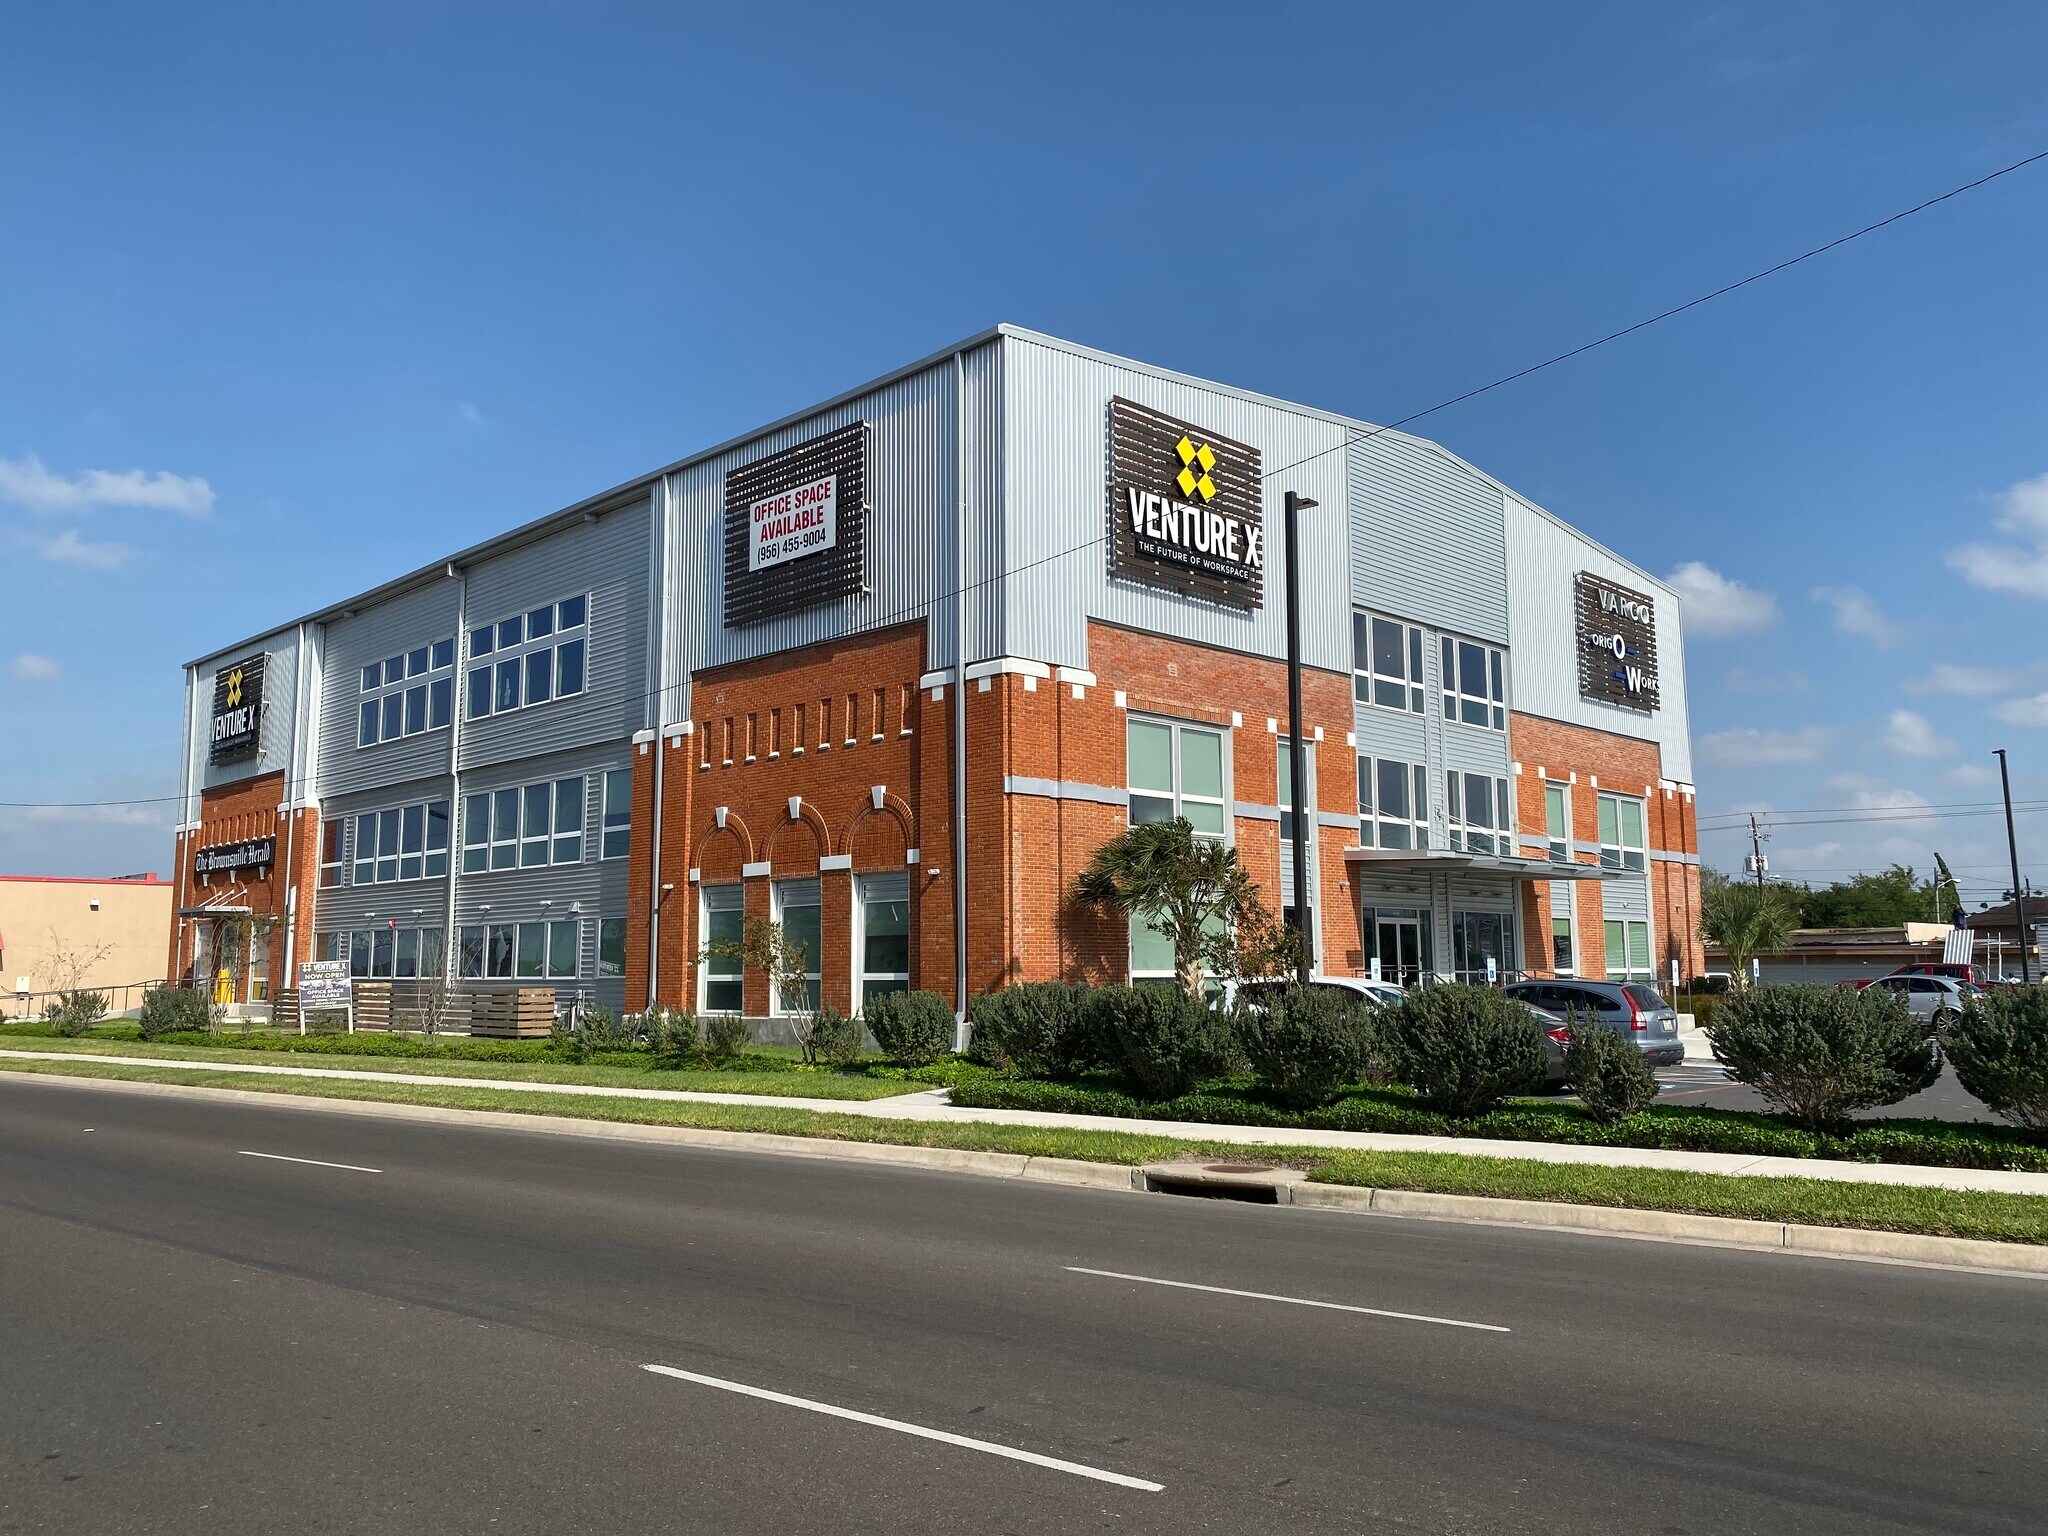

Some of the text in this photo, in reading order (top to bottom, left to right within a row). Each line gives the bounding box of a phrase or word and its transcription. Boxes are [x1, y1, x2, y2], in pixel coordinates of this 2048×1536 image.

[754, 480, 831, 523] OFFICE SPACE
[760, 505, 824, 543] AVAILABLE
[1128, 487, 1261, 568] VENTURE X
[757, 527, 827, 565] (956) 455-9004
[1139, 541, 1249, 579] THE FUTURE OF WORKSPACE
[1597, 588, 1650, 624] VARCO
[211, 706, 248, 742] VENTURE
[247, 704, 256, 731] X
[196, 841, 271, 872] The Brownsville Herald
